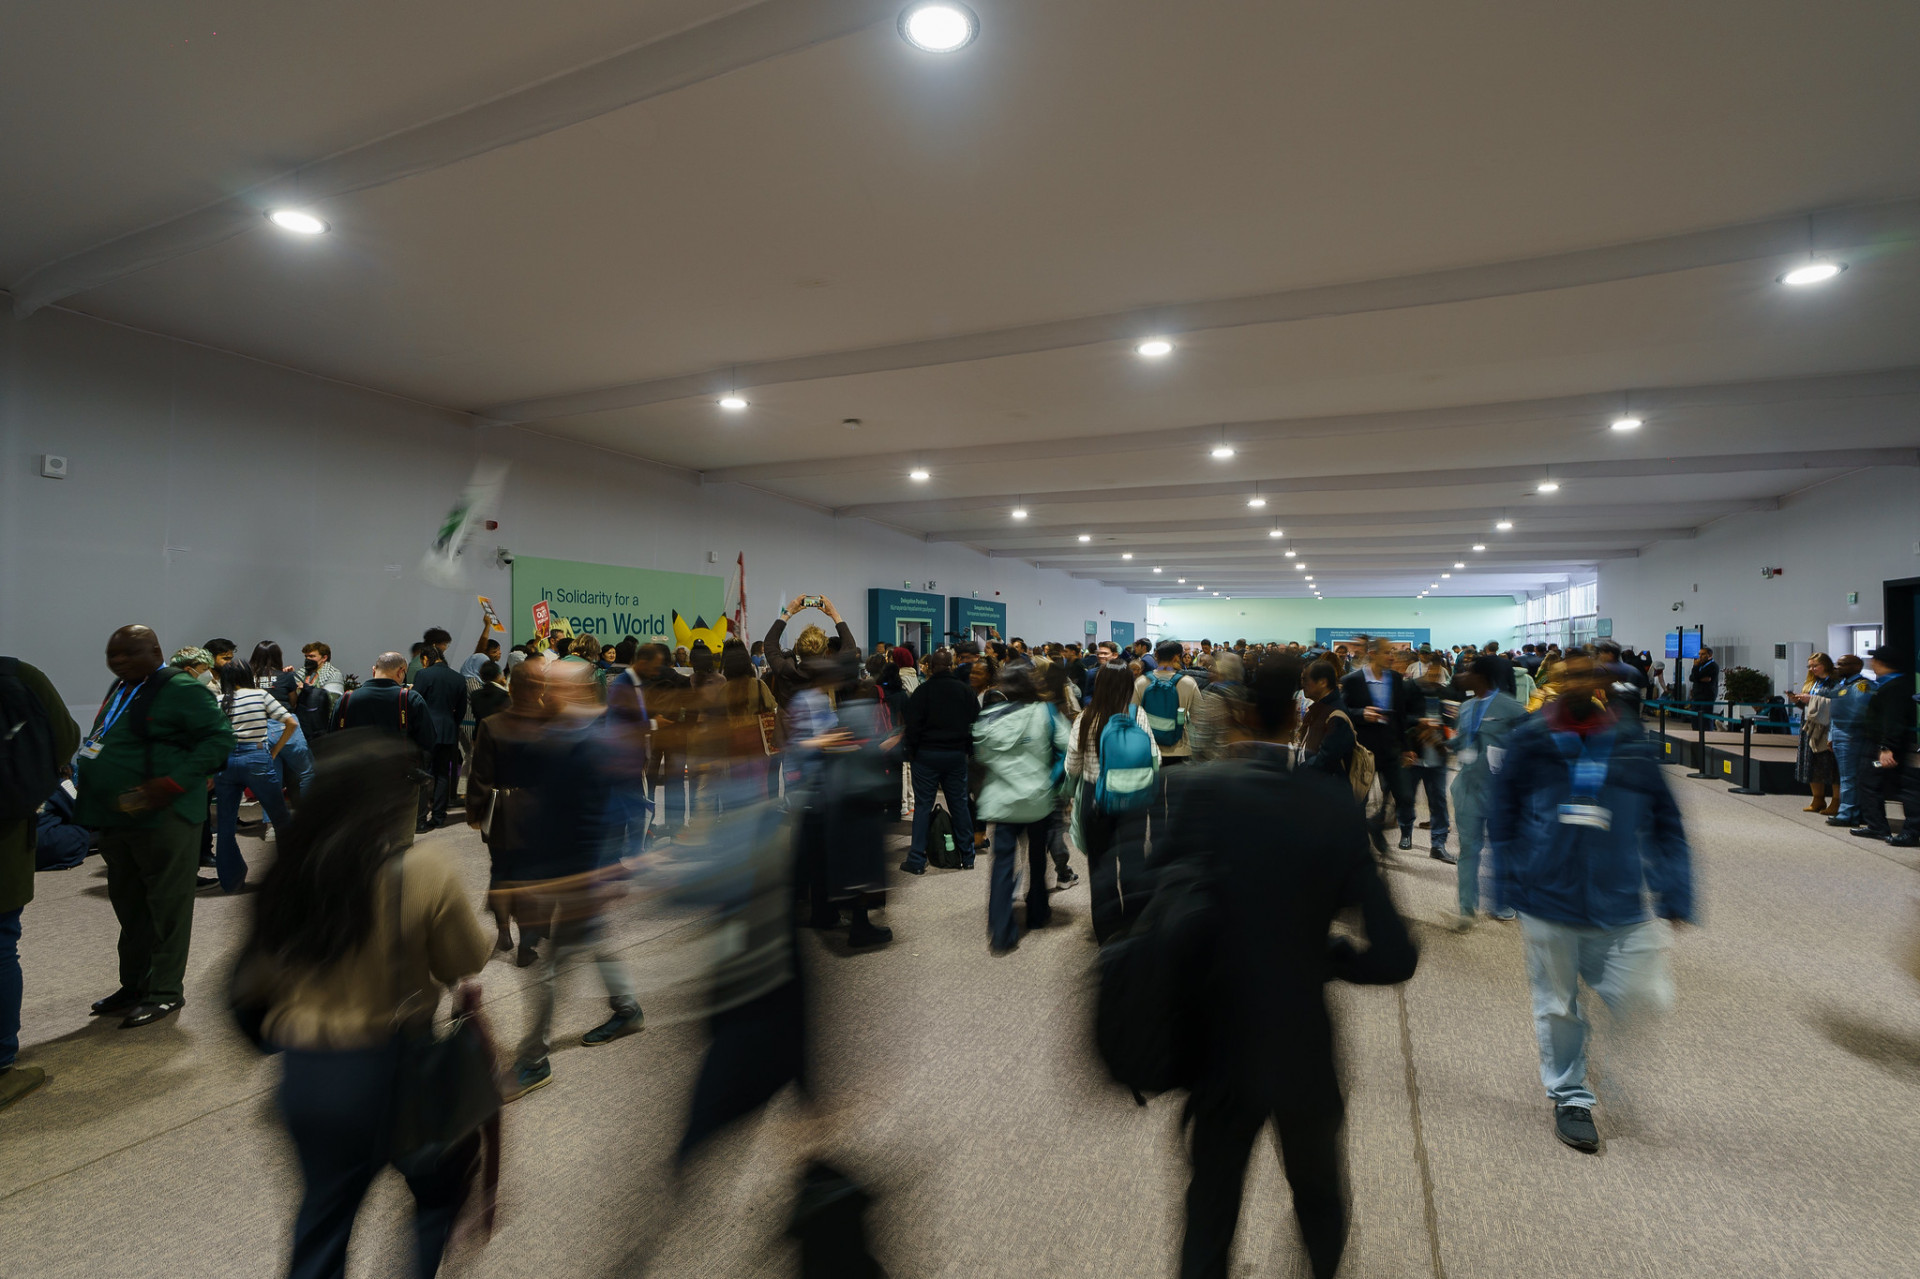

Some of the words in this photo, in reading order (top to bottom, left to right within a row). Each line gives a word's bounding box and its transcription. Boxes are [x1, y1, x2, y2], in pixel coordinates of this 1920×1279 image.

[541, 587, 553, 601] In
[556, 588, 612, 607] Solidarity
[614, 592, 630, 605] for
[632, 595, 639, 606] a
[612, 612, 664, 635] World
